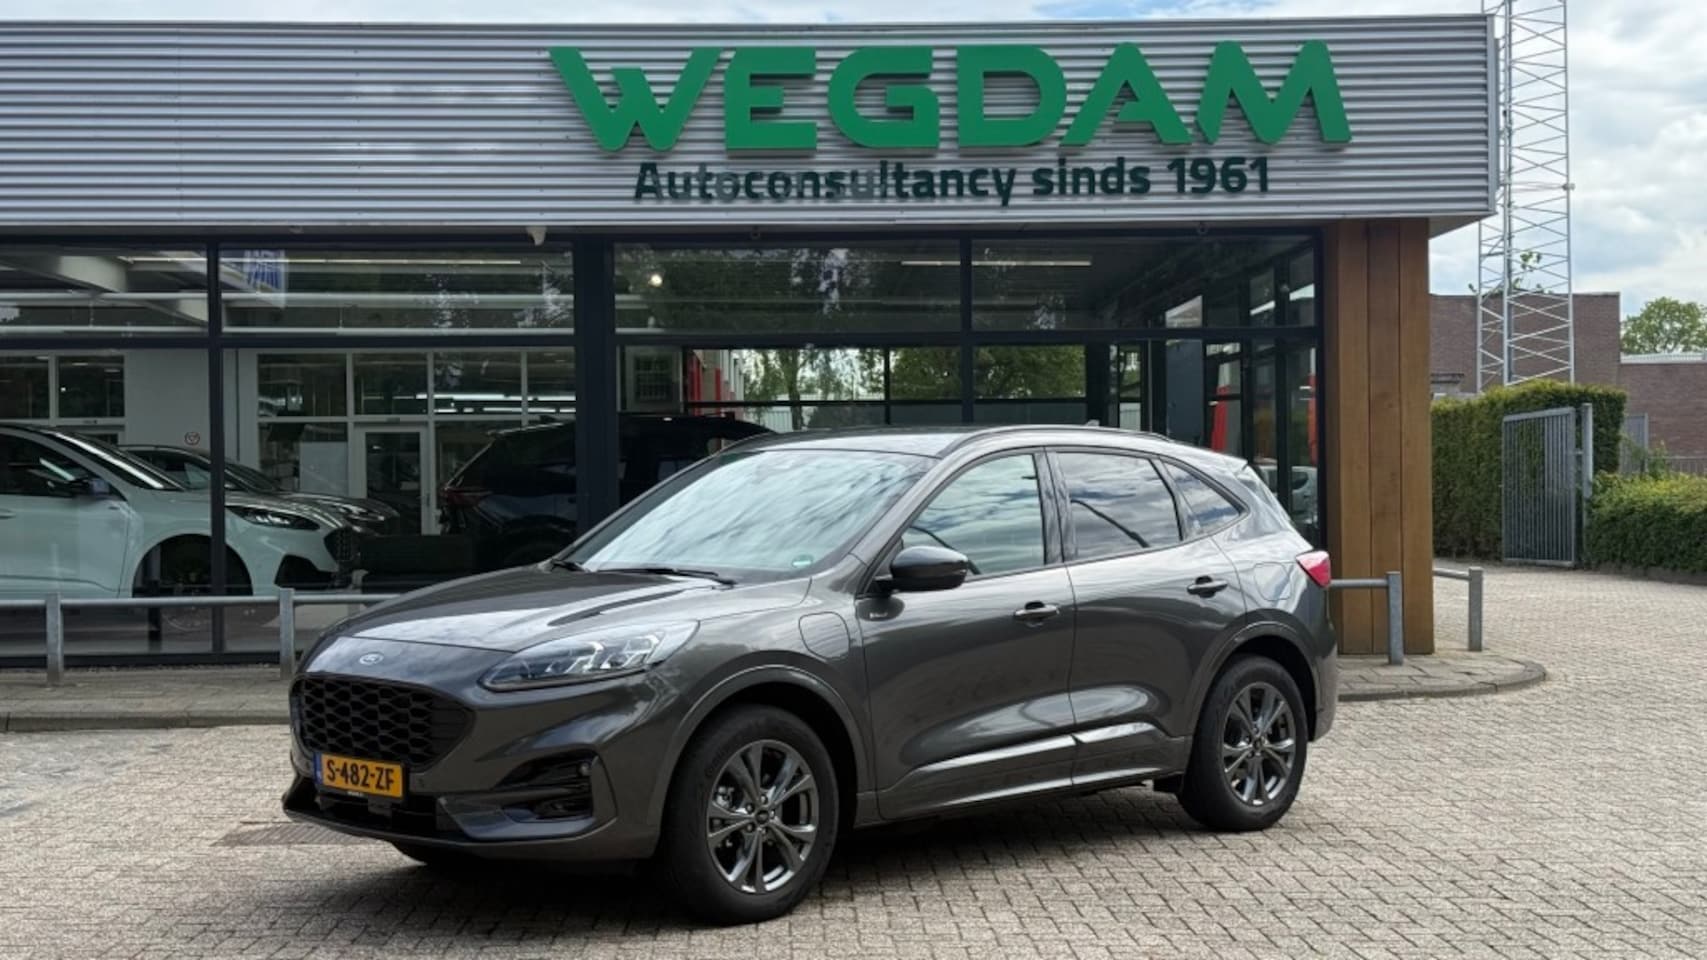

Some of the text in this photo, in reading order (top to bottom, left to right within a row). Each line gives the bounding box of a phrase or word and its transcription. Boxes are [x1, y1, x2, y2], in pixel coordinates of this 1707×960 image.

[548, 40, 1353, 152] WEGDAM
[634, 156, 1268, 207] Autoconsultancy sinds 1961
[326, 759, 394, 791] S-482-ZF
